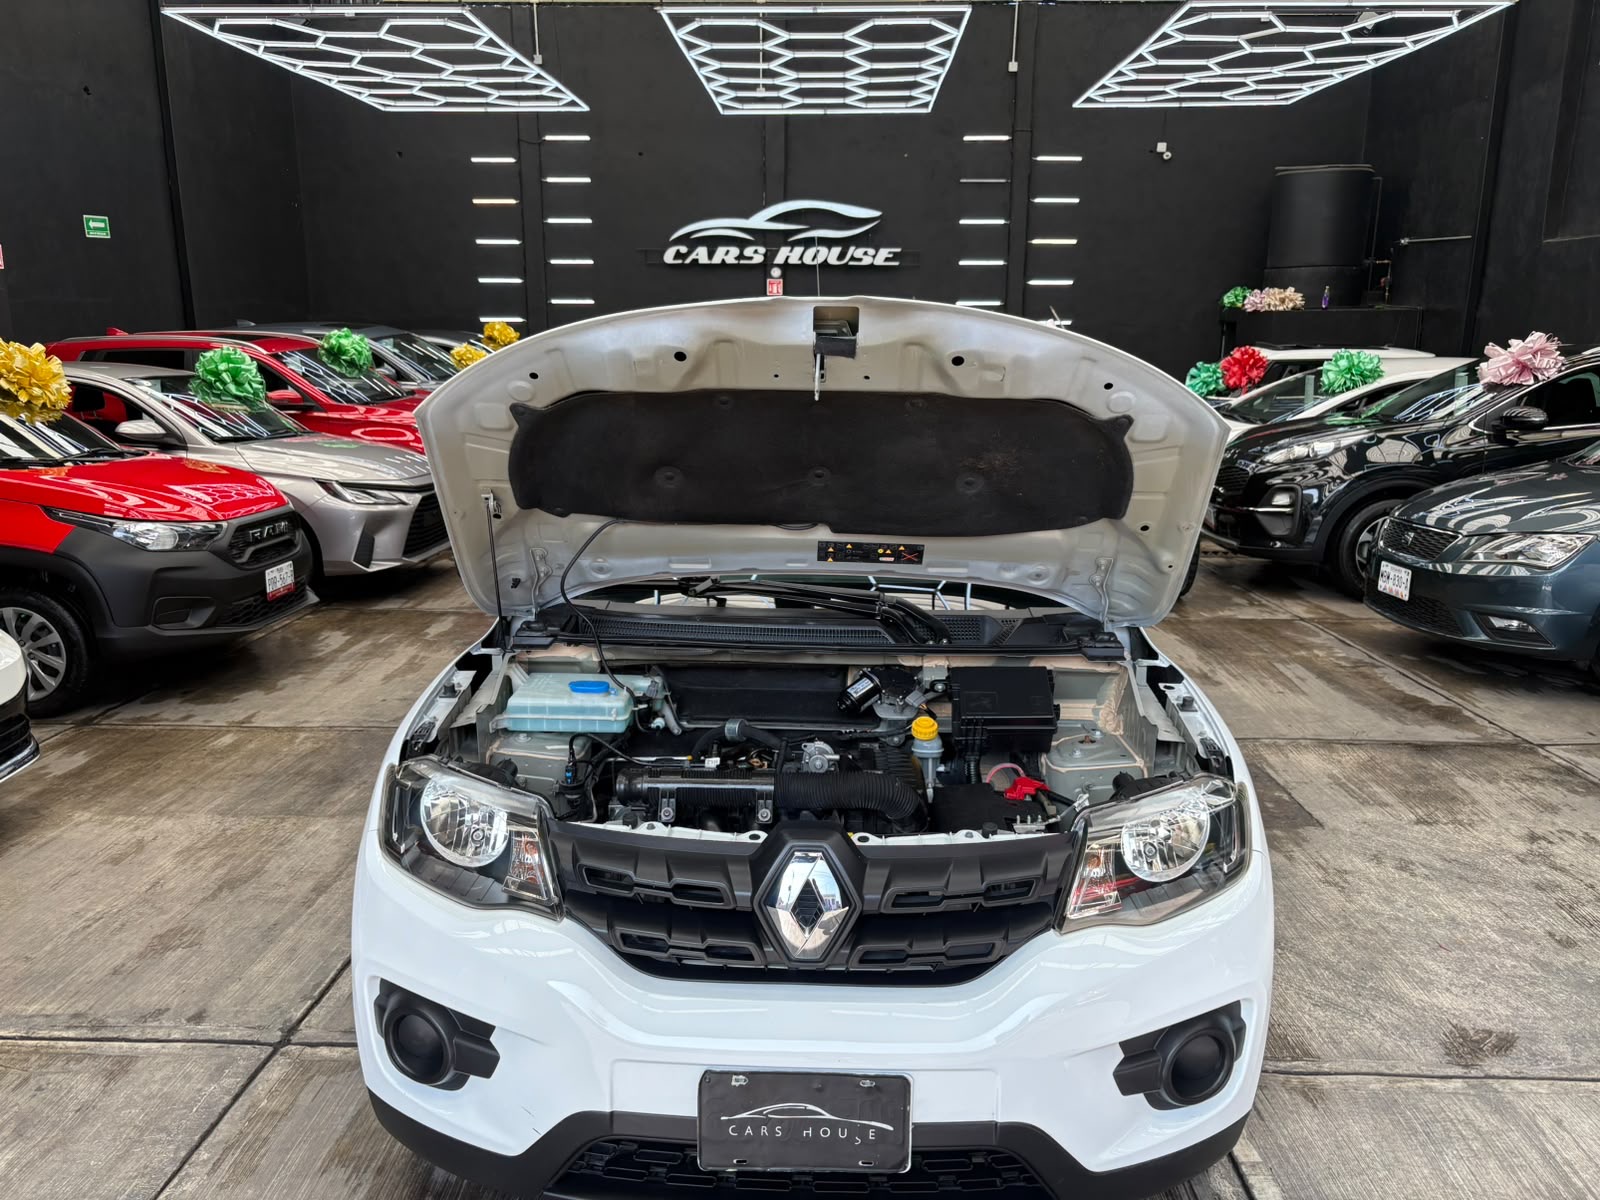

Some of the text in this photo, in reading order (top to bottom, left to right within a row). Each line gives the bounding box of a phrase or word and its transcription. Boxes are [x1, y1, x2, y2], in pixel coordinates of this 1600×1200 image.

[663, 245, 902, 266] CARS HOUSE
[249, 521, 289, 542] RAM
[728, 1124, 783, 1137] CARS
